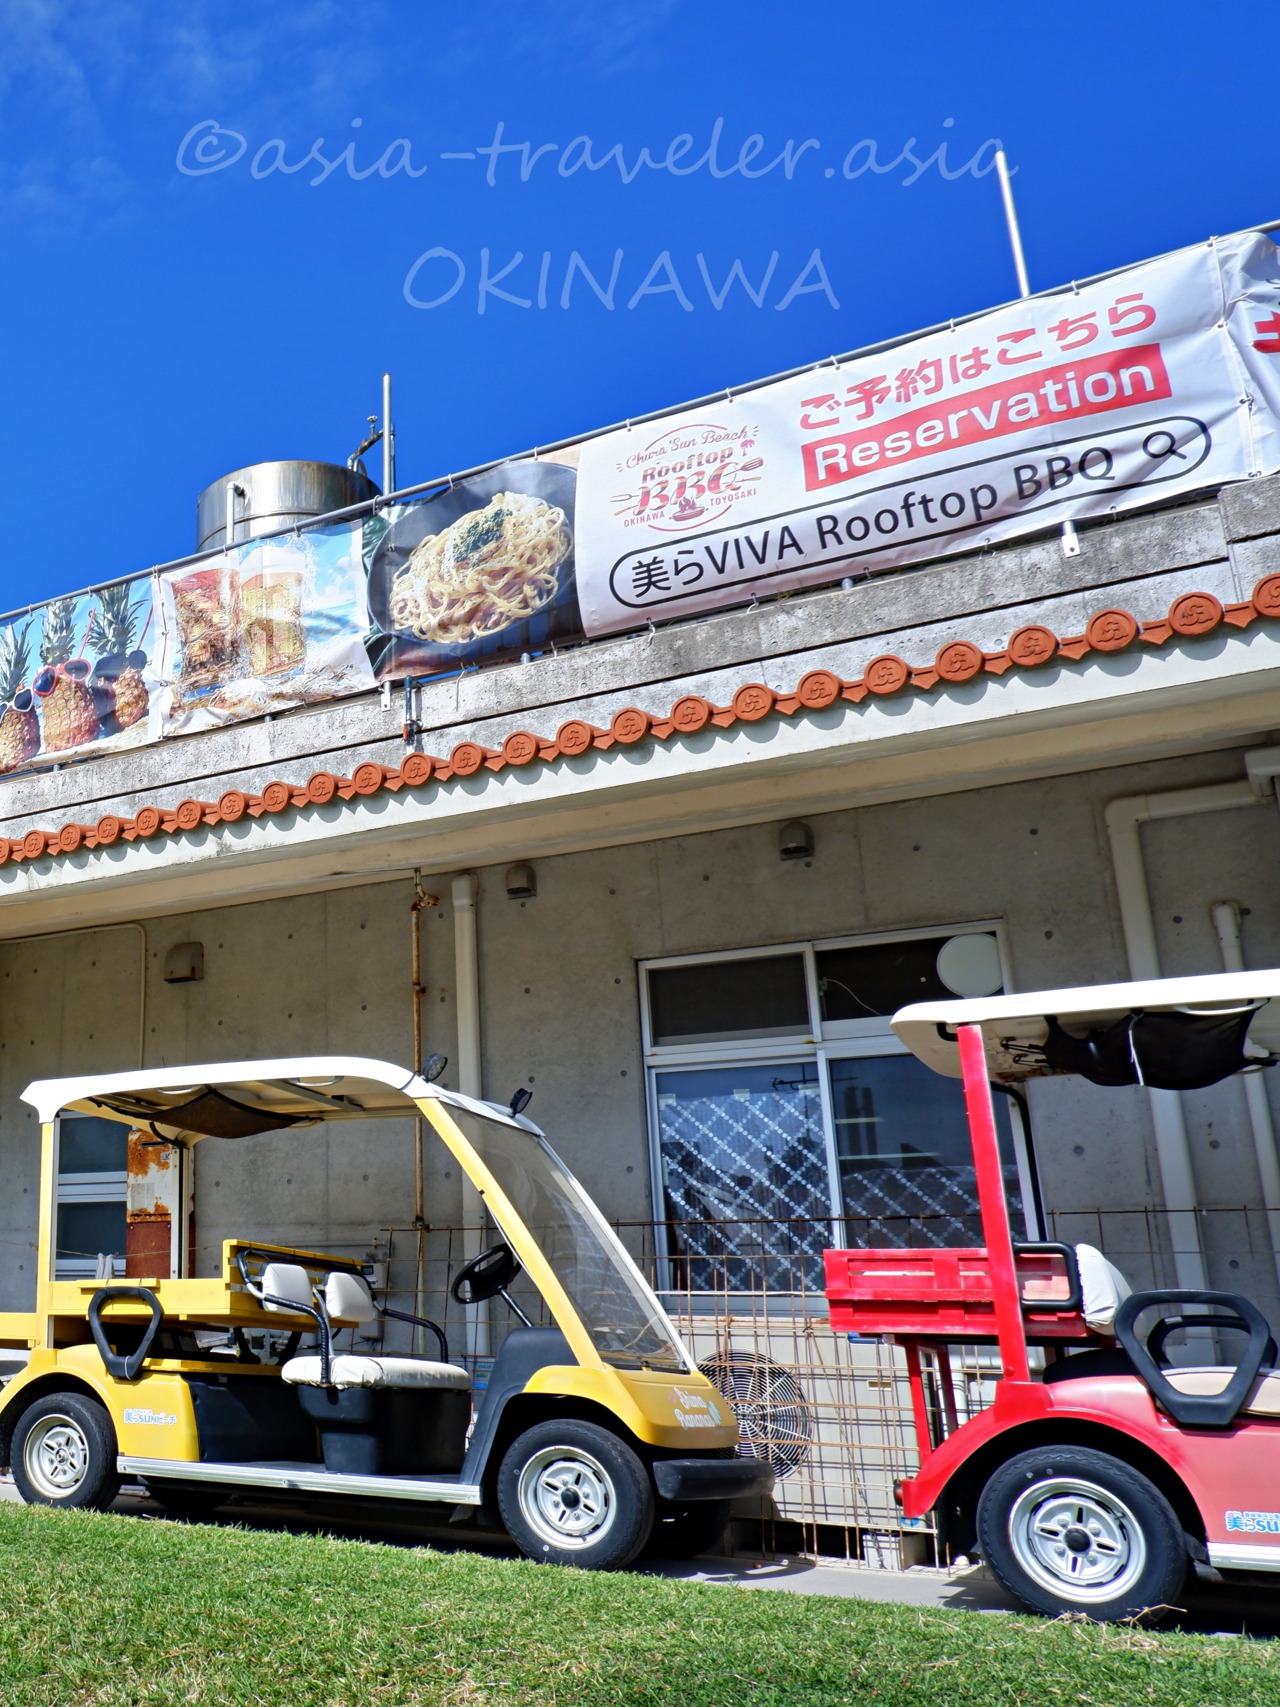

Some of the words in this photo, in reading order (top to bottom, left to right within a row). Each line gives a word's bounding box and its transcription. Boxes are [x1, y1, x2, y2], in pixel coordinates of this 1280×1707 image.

[799, 292, 1157, 431] ご予約はこちら
[626, 445, 667, 469] Chura
[701, 425, 749, 445] Beach
[815, 360, 1157, 481] Reservation
[632, 461, 742, 517] BBQ
[642, 446, 734, 484] Rooftop
[623, 510, 666, 528] OKINAWA
[709, 487, 757, 507] TOYOSAKI
[630, 520, 805, 600] 美らVIVA
[817, 479, 998, 548] Rooftop
[1013, 446, 1117, 502] BBQ
